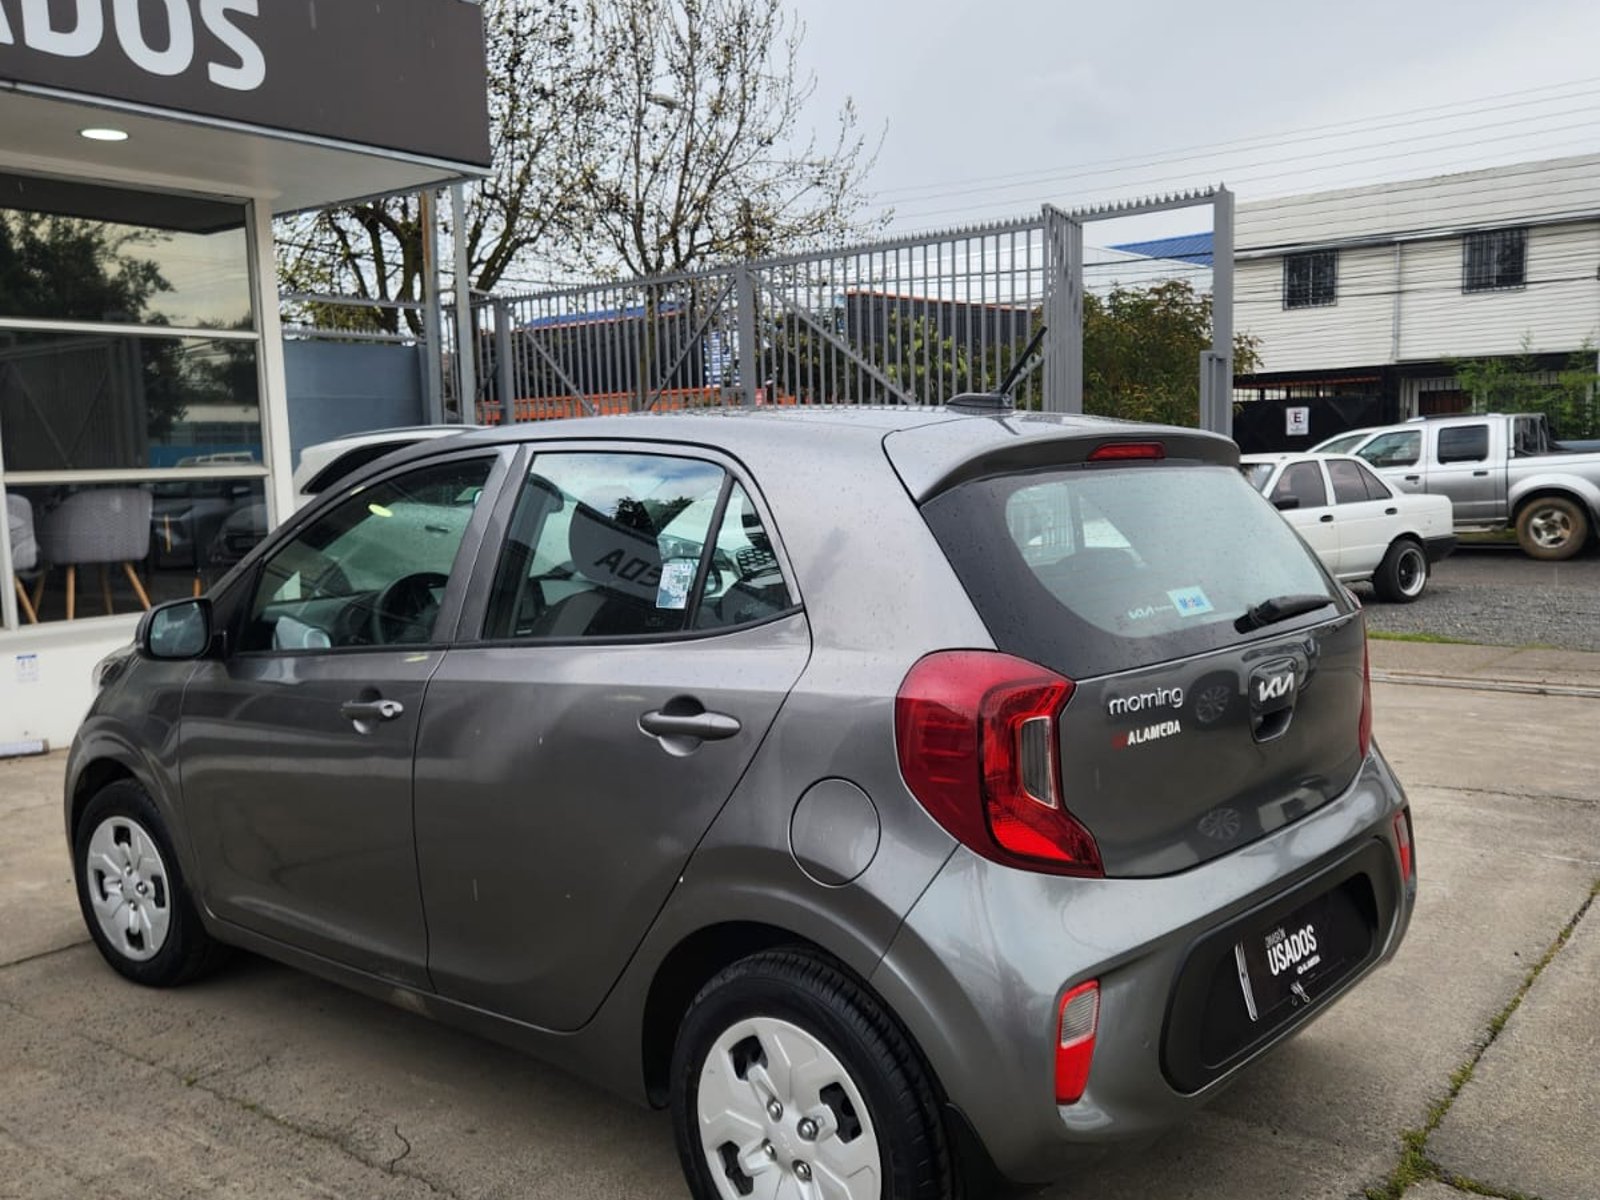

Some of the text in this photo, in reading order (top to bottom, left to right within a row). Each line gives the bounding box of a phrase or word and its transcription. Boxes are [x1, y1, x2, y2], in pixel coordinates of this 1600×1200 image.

[0, 0, 266, 91] DOS
[1294, 412, 1303, 423] E
[1108, 686, 1184, 716] morning
[1127, 719, 1182, 747] ALAMEDA
[1267, 924, 1318, 977] USADOS
